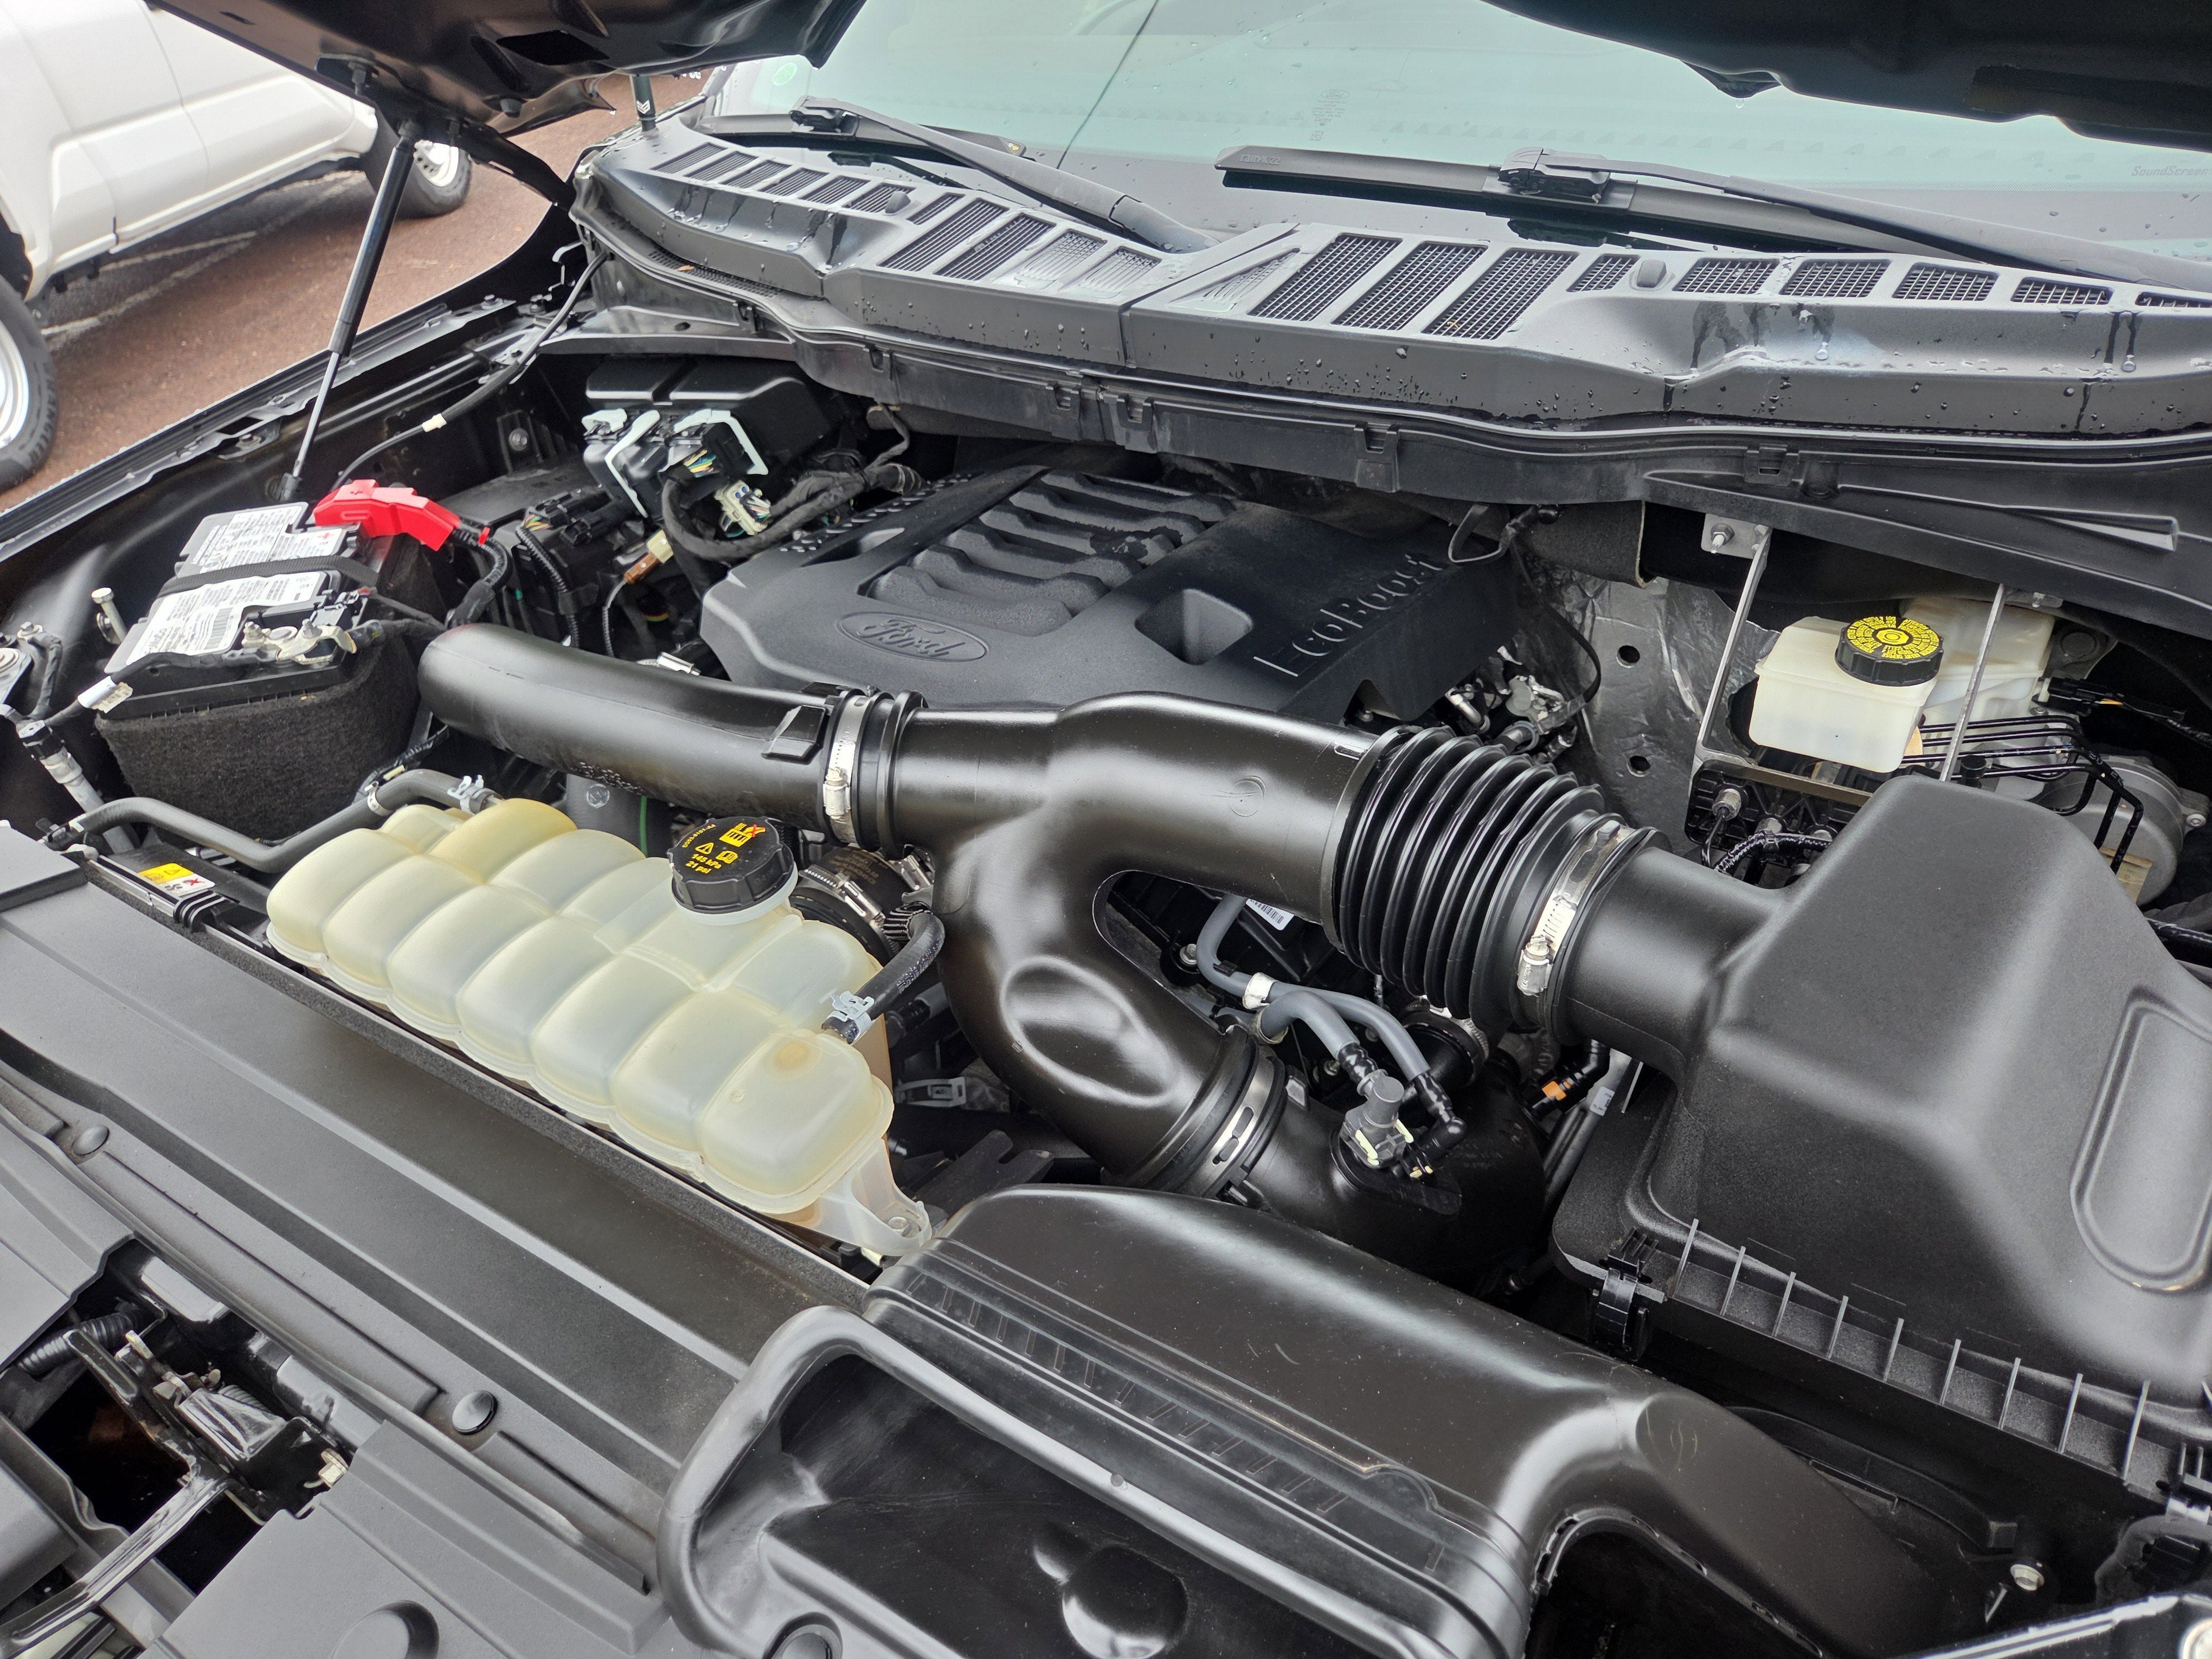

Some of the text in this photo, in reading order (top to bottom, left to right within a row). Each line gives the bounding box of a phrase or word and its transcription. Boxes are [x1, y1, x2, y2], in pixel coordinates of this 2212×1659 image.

[2131, 165, 2209, 176] SoundScreen
[856, 619, 967, 657] Ford
[705, 859, 722, 869] kPa
